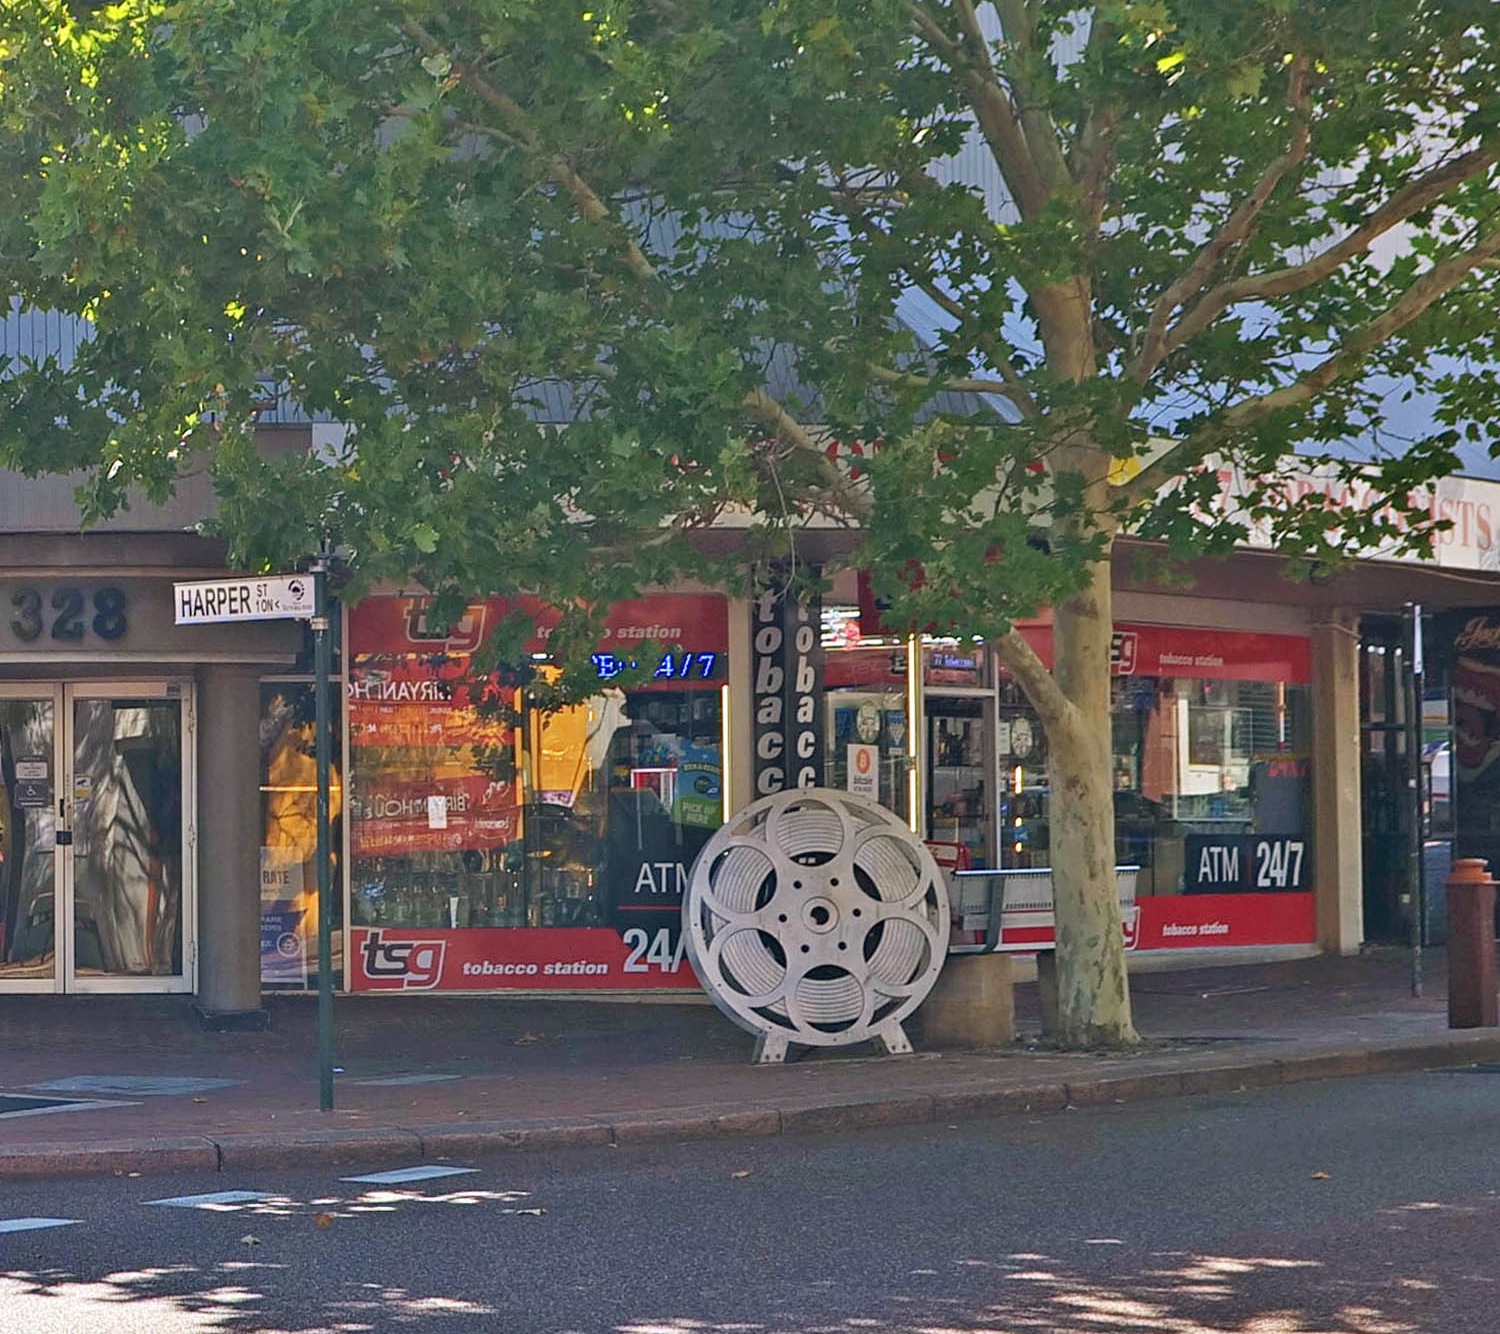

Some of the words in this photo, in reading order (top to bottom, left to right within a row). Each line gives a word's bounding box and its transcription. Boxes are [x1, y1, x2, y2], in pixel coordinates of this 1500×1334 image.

[10, 586, 129, 642] 328
[181, 585, 251, 617] HARPER
[256, 584, 268, 598] ST
[617, 625, 682, 640] station
[1198, 846, 1239, 883] ATM
[1256, 840, 1305, 887] 24/7
[1162, 922, 1198, 936] tobacco
[1199, 921, 1229, 934] station
[362, 930, 445, 988] tsg
[462, 961, 538, 975] tobacco
[544, 960, 608, 975] station
[622, 928, 686, 973] 24/
